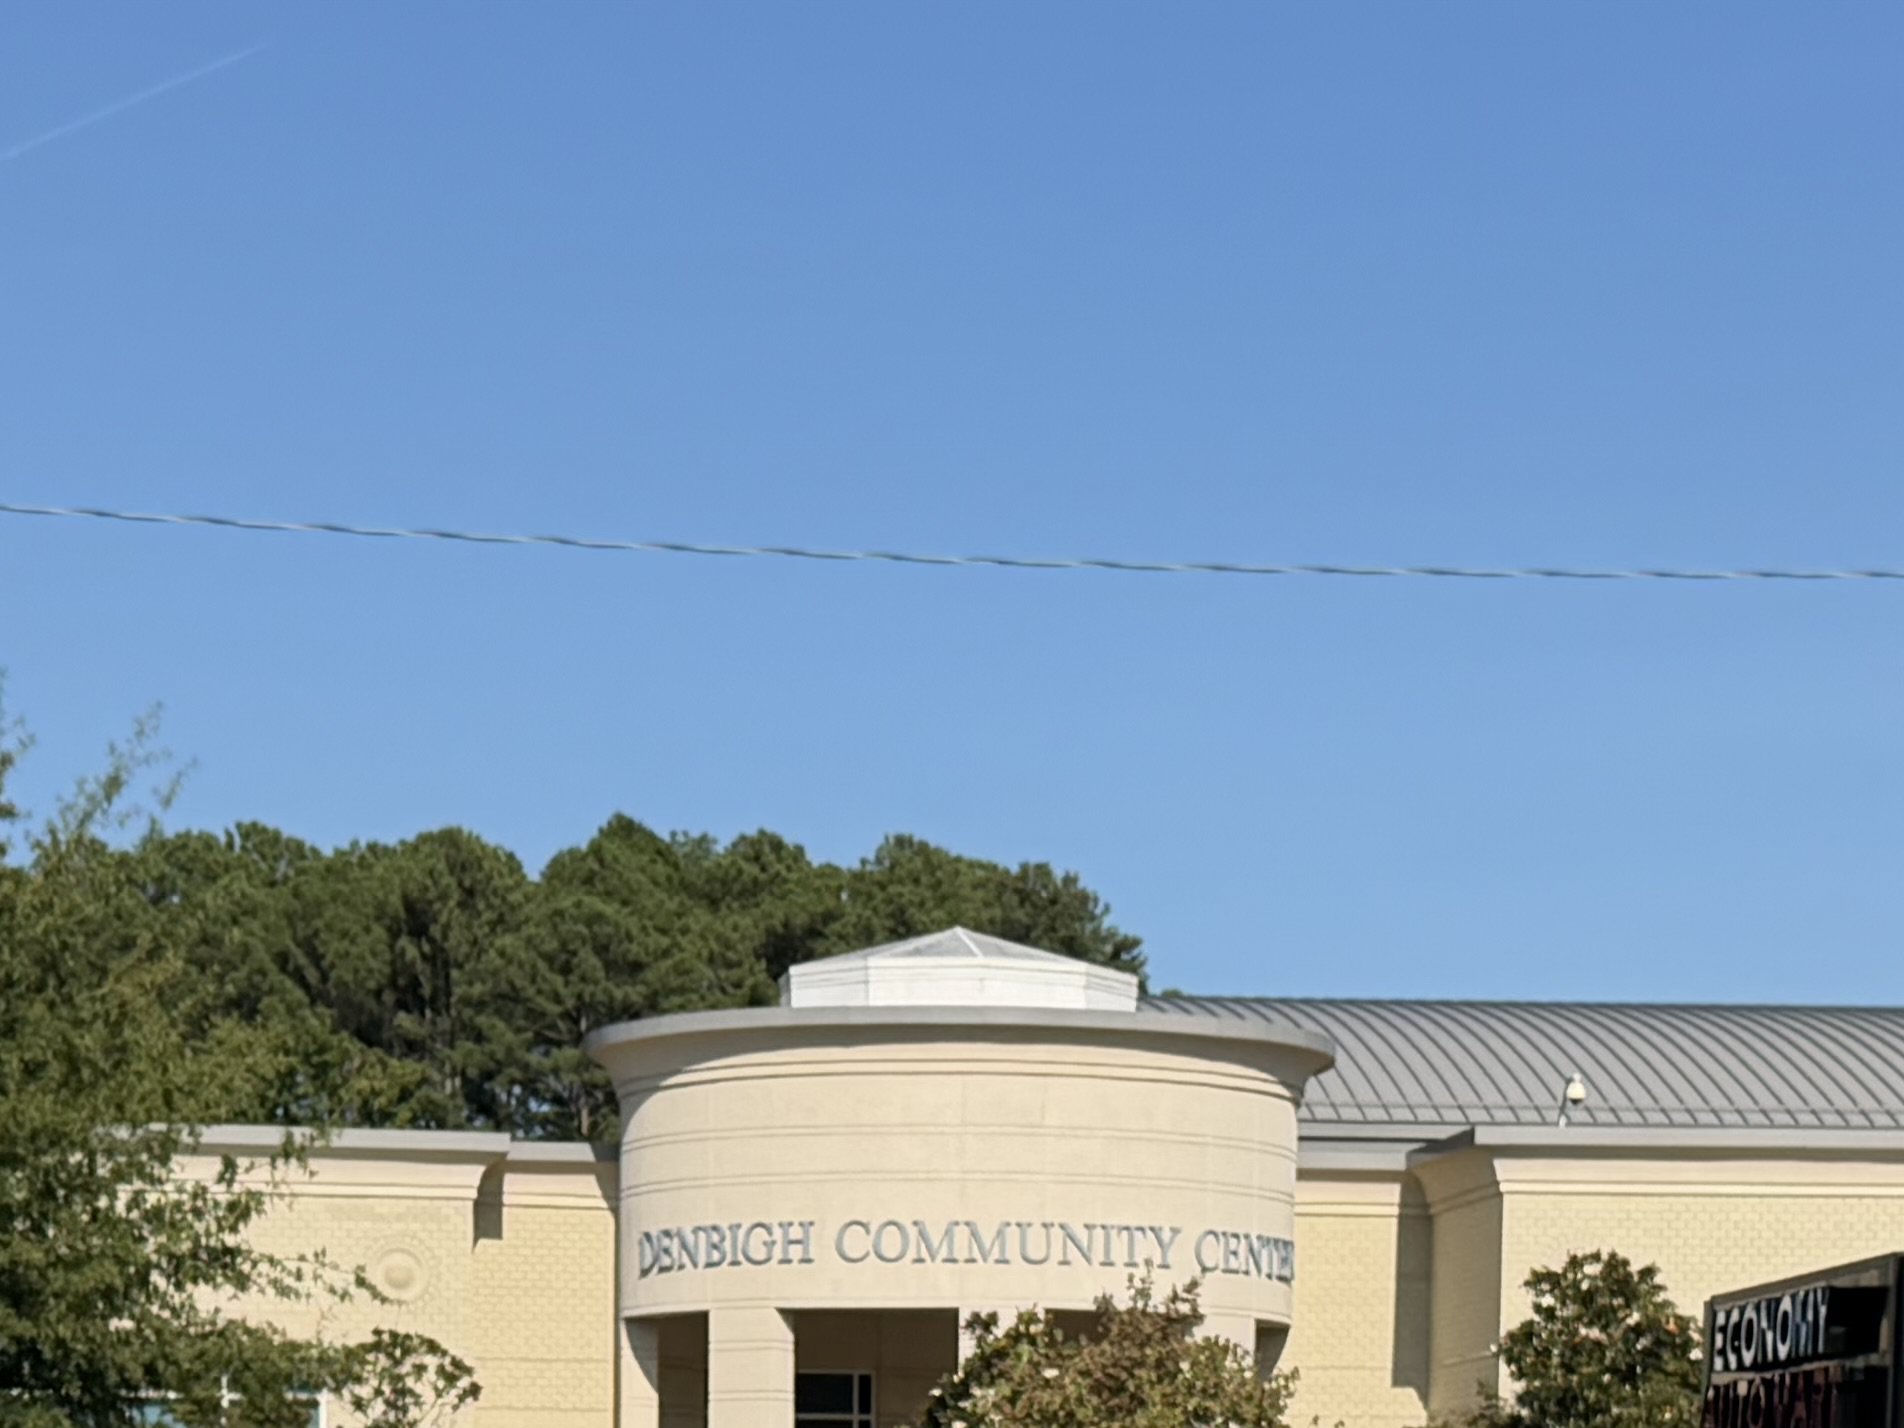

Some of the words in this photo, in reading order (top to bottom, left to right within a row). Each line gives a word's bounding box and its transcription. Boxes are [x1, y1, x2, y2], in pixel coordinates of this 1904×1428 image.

[637, 1220, 816, 1279] DENBIGH
[834, 1219, 1182, 1269] COMMUNITY
[1713, 1288, 1830, 1372] ECONOMY
